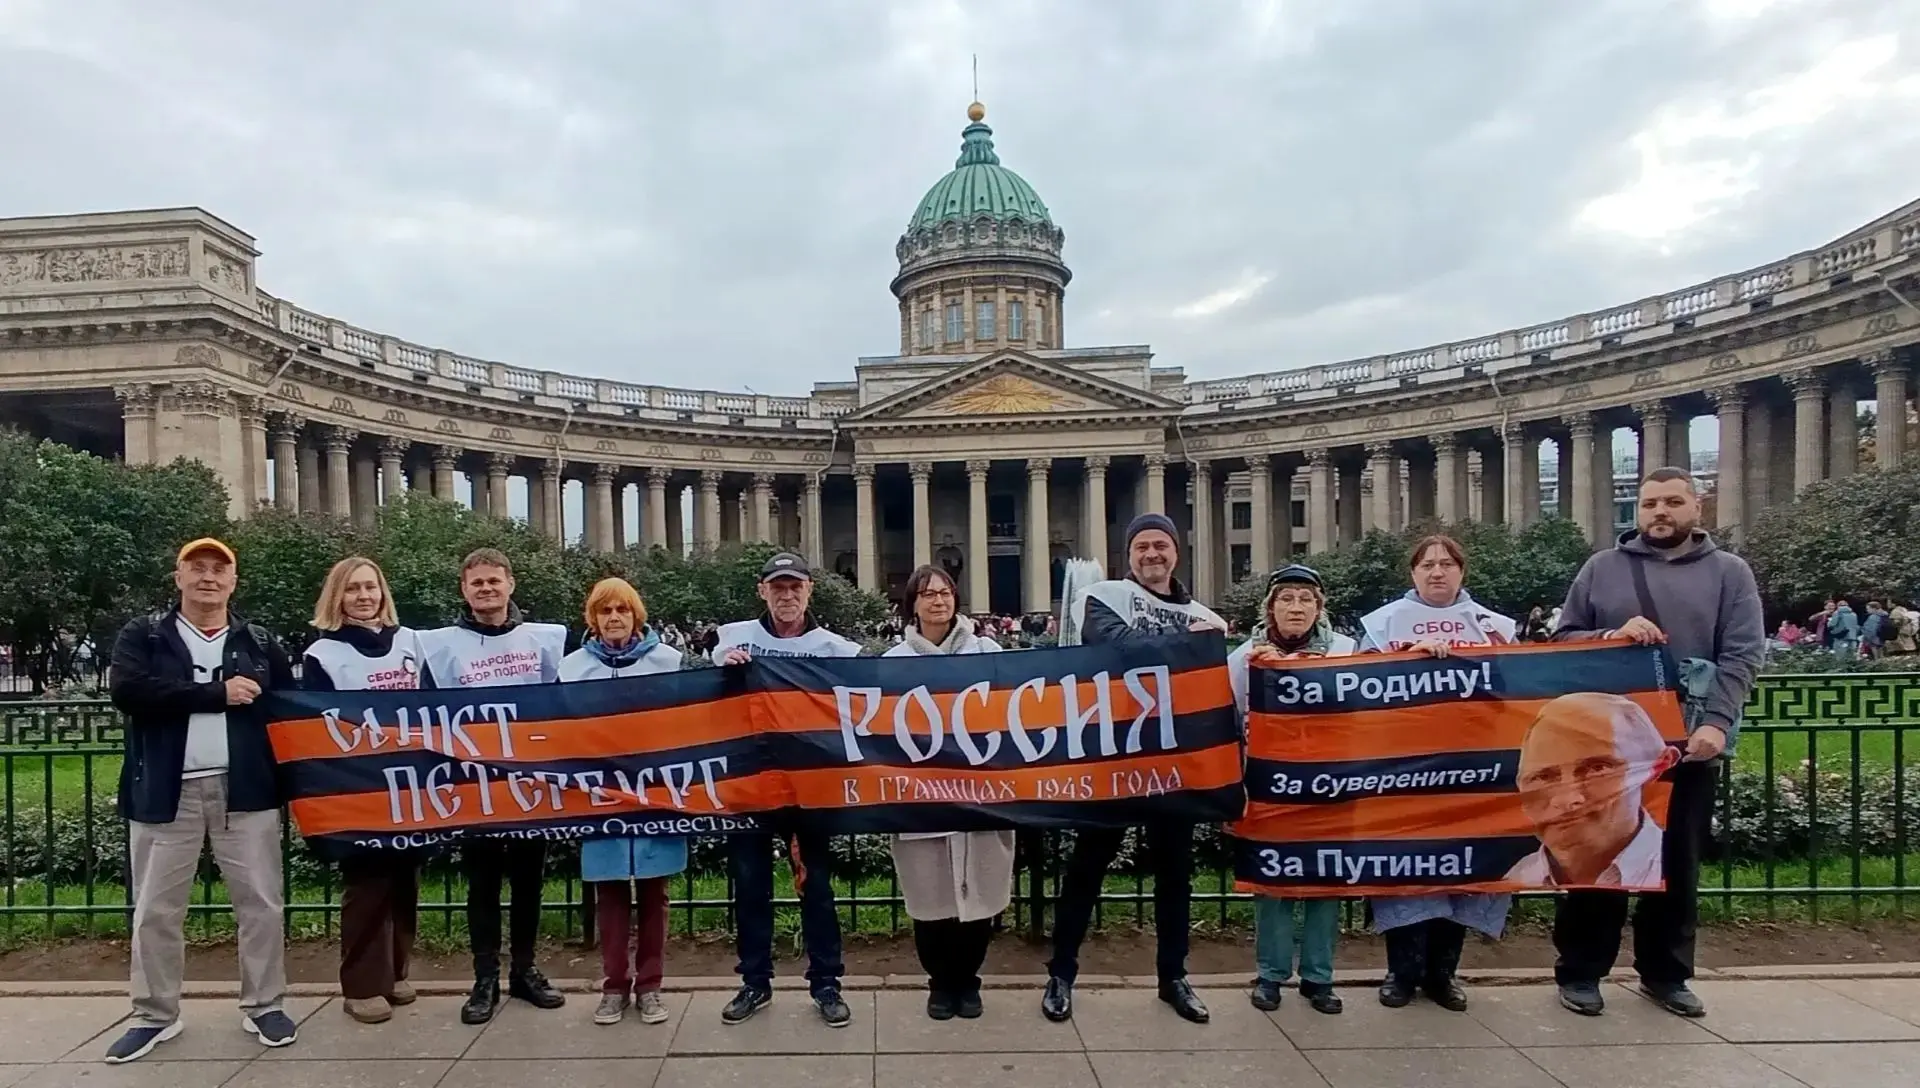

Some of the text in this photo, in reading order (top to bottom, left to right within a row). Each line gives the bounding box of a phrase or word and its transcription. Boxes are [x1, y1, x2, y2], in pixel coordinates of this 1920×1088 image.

[1412, 620, 1465, 635] СБОР
[367, 670, 400, 683] СБОР
[458, 663, 543, 686] СБОР ПОДПИС
[470, 651, 538, 670] НАРОДНЫЙ
[1277, 662, 1493, 705] За Родину!
[832, 665, 1178, 766] РОССИЯ
[381, 755, 729, 825] ПЕТЕРБУРГ
[843, 765, 1183, 805] В ГРАНИЦАХ 1945 ГОДА
[1270, 763, 1501, 797] За Суверенитет!
[1259, 846, 1474, 886] За Путина!
